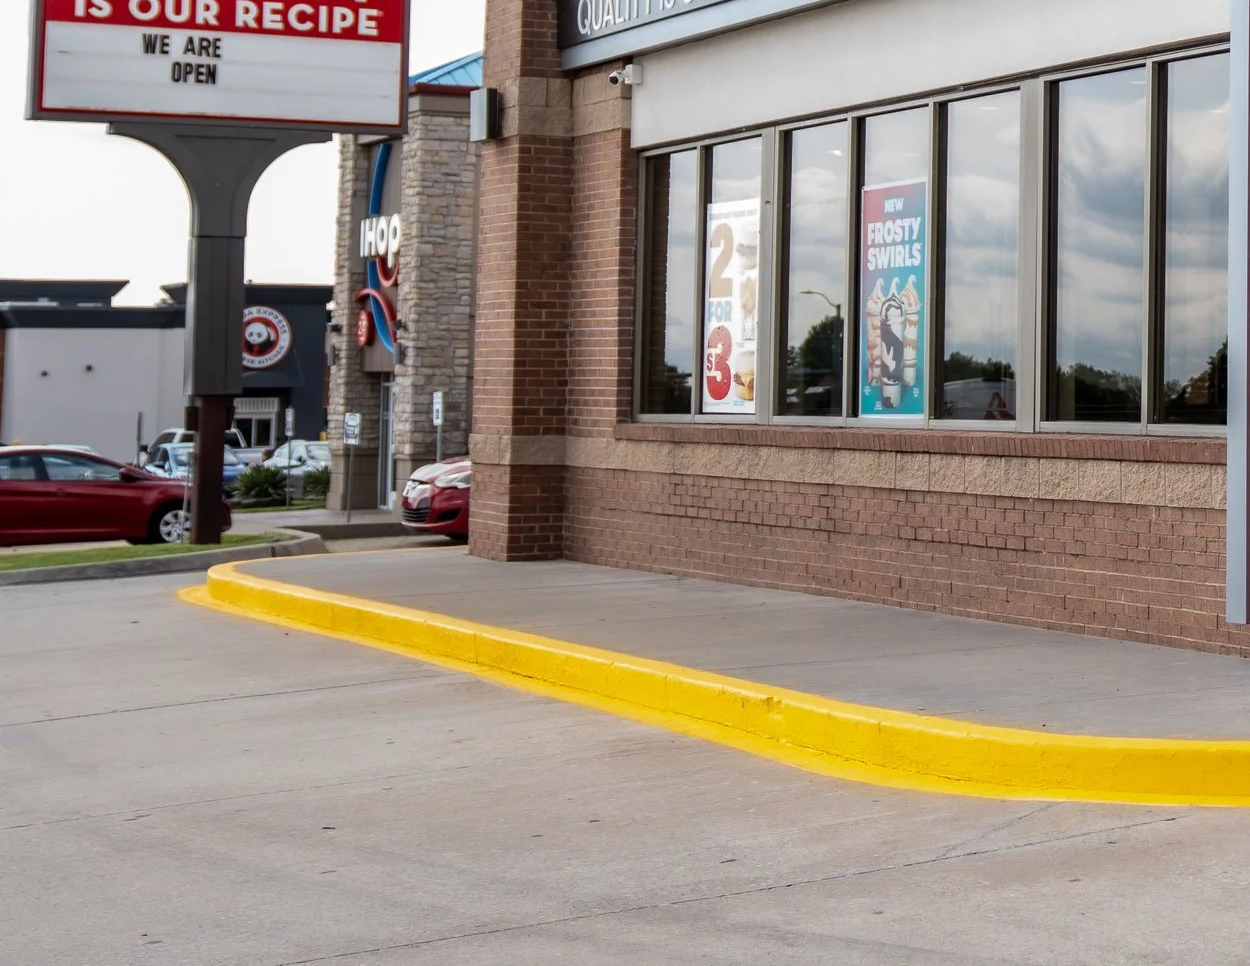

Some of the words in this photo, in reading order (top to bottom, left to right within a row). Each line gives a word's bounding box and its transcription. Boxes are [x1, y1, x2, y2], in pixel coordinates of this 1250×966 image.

[235, 1, 380, 36] RECIPE
[141, 33, 170, 55] WE
[184, 36, 223, 59] ARE
[171, 61, 218, 85] OPEN
[884, 197, 904, 213] NEW
[360, 213, 401, 268] IHOP
[867, 216, 921, 245] FROSTY
[709, 223, 734, 299] 2
[867, 243, 921, 271] SWIRLS
[708, 300, 732, 323] FOR
